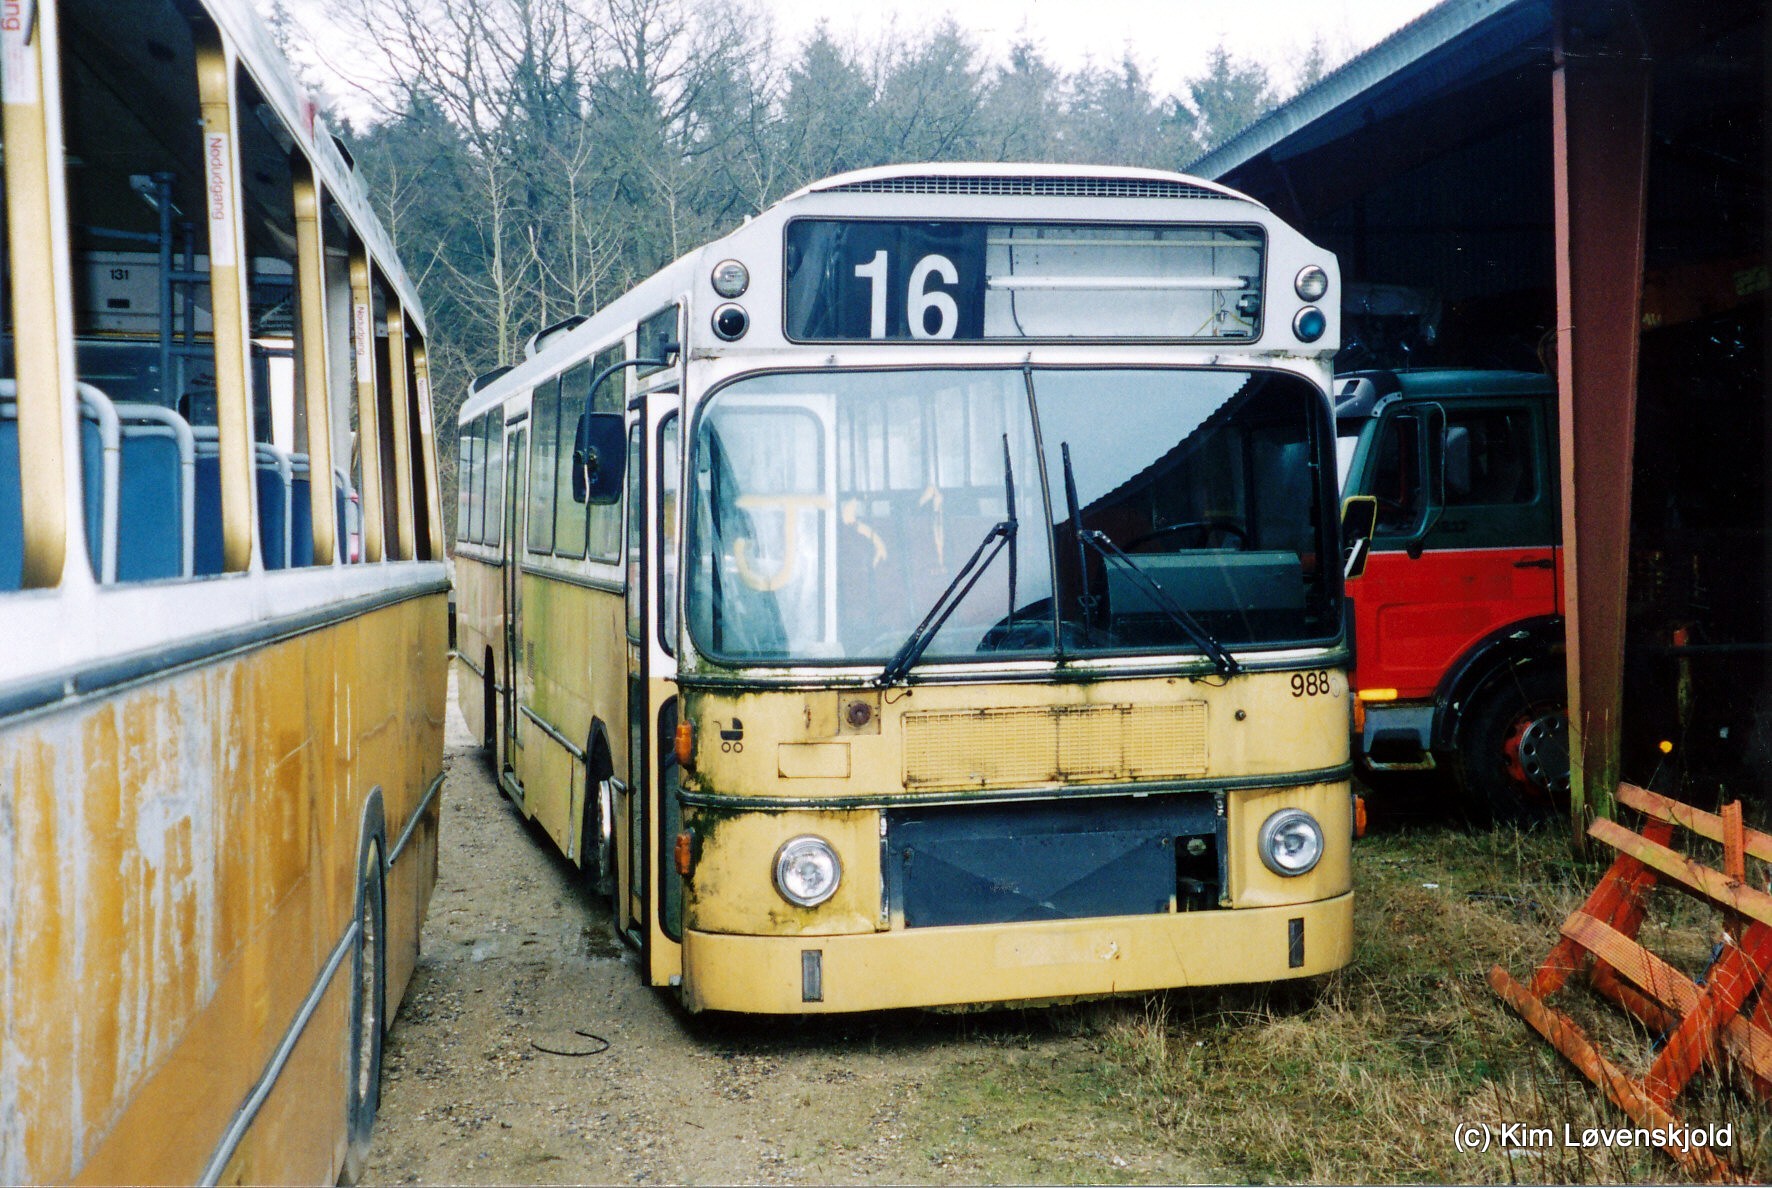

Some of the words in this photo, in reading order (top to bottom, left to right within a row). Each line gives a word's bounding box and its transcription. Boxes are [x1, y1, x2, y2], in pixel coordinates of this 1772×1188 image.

[109, 269, 130, 281] 131
[855, 250, 959, 340] 16
[1291, 670, 1330, 697] 988
